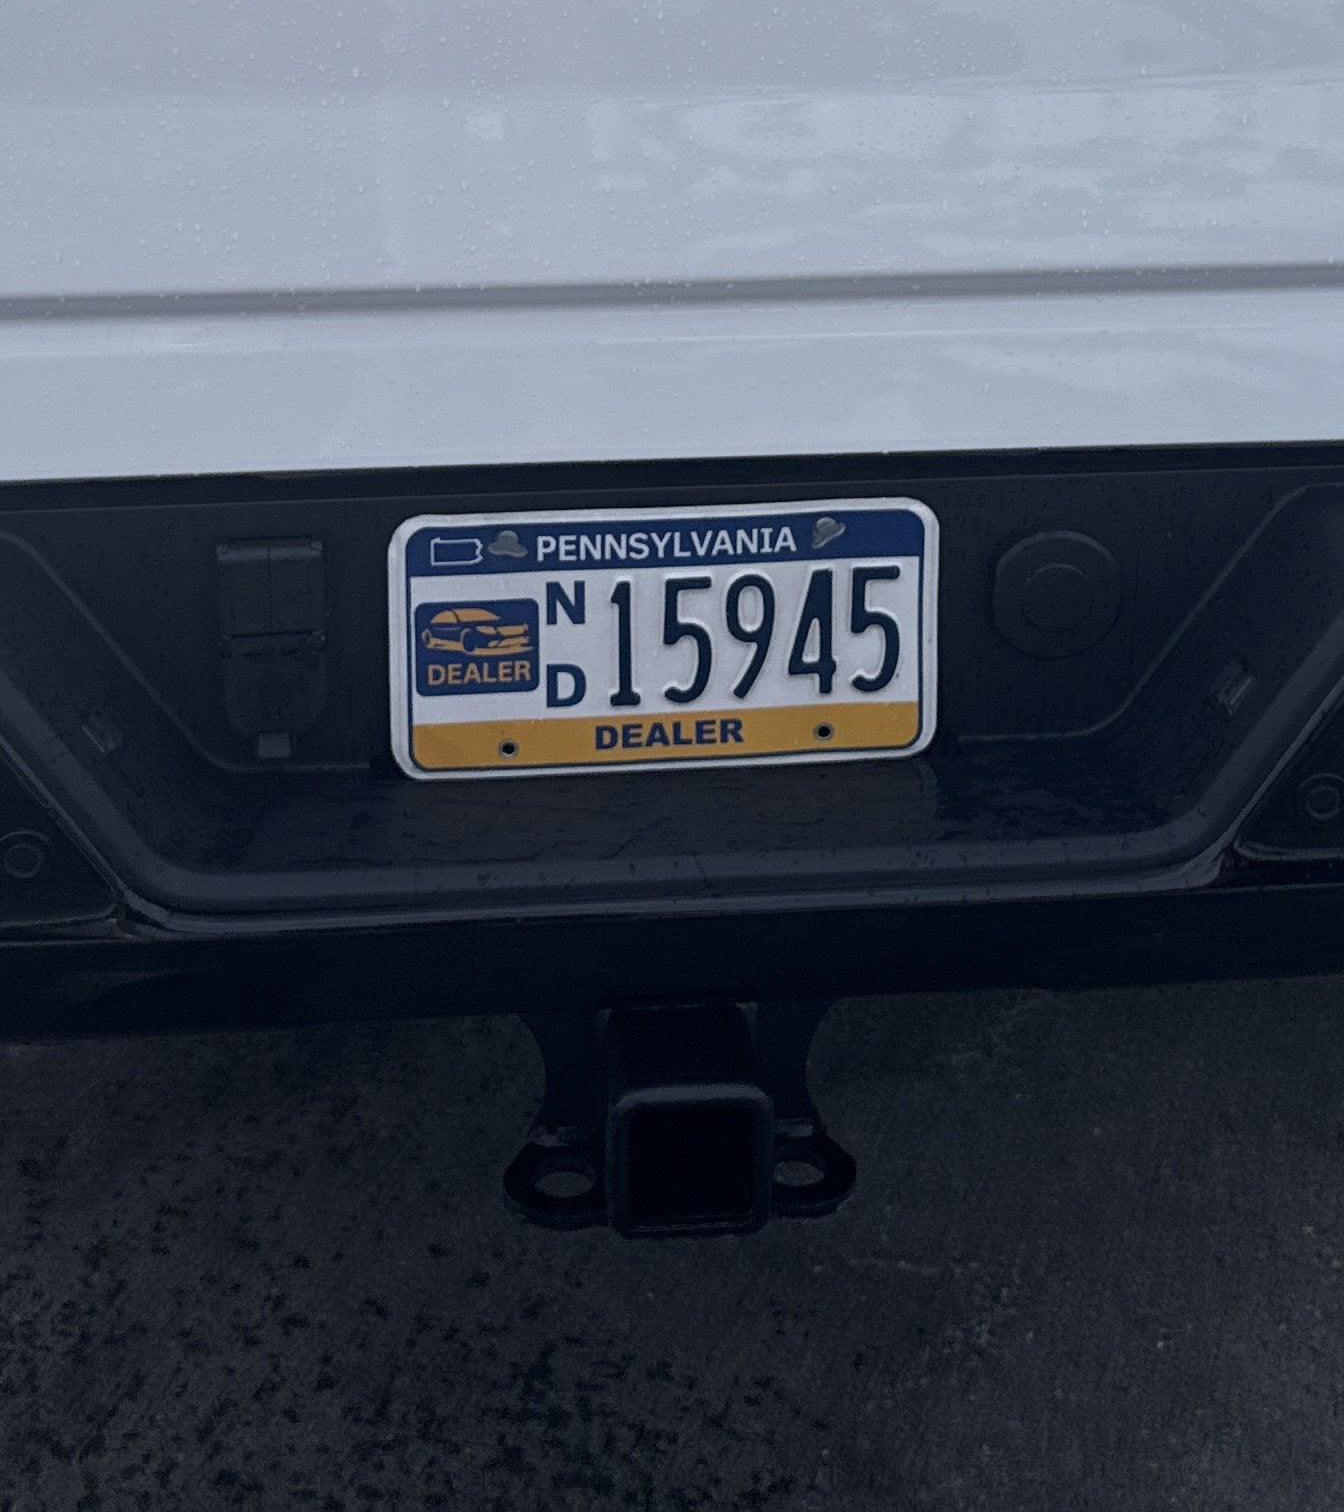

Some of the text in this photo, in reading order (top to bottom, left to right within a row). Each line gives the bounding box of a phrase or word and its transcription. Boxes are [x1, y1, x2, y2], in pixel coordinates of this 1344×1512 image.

[536, 526, 797, 562] PENNSYLVANIA
[609, 565, 901, 707] 15945
[427, 660, 532, 685] DEALER
[595, 718, 745, 750] DEALER
